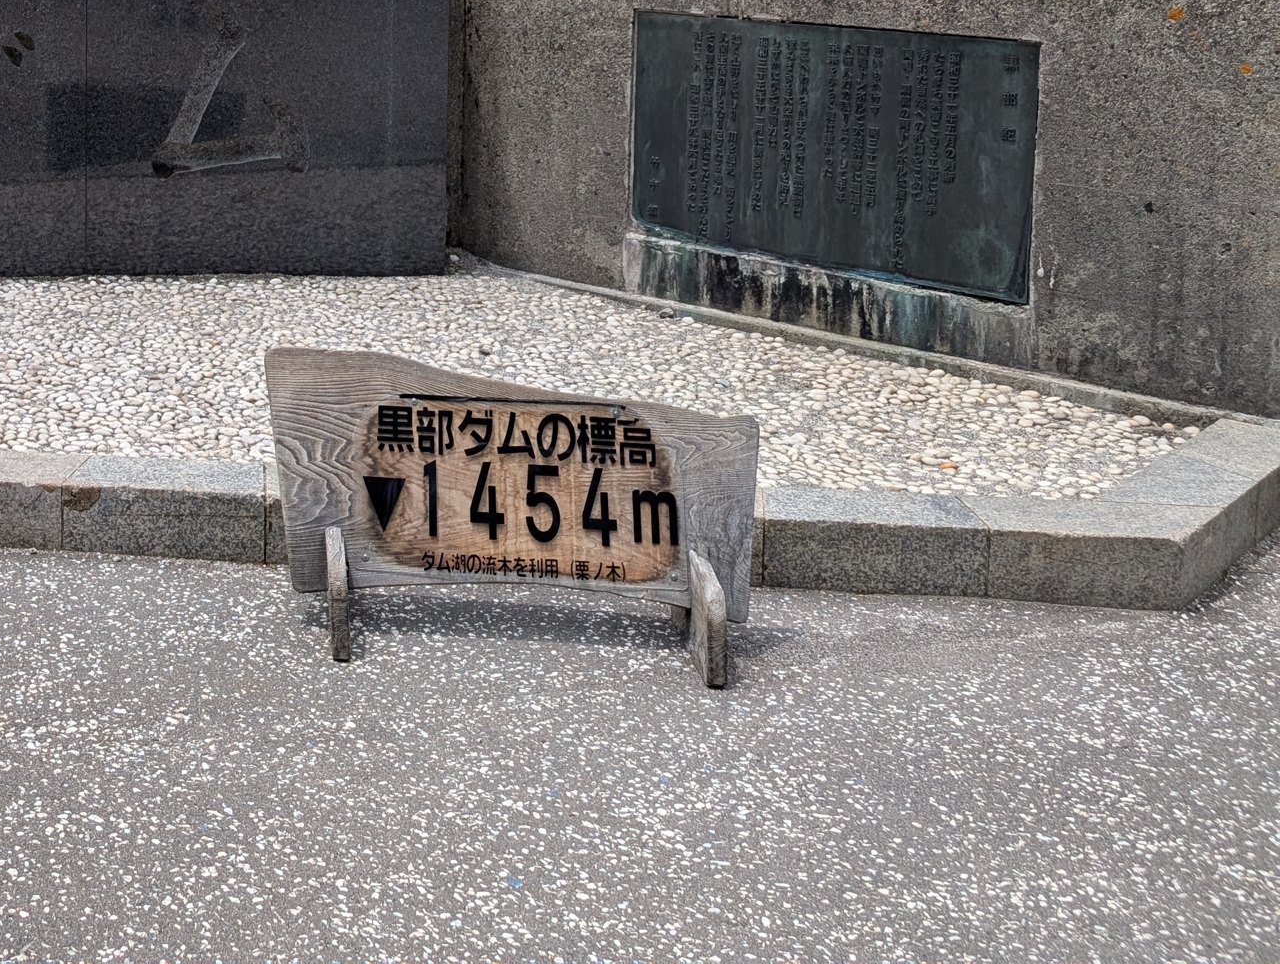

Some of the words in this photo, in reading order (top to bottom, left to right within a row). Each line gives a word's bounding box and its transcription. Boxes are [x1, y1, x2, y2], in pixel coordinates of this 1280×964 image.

[376, 405, 657, 468] 黒部ダムの標高
[423, 460, 679, 547] 1454m
